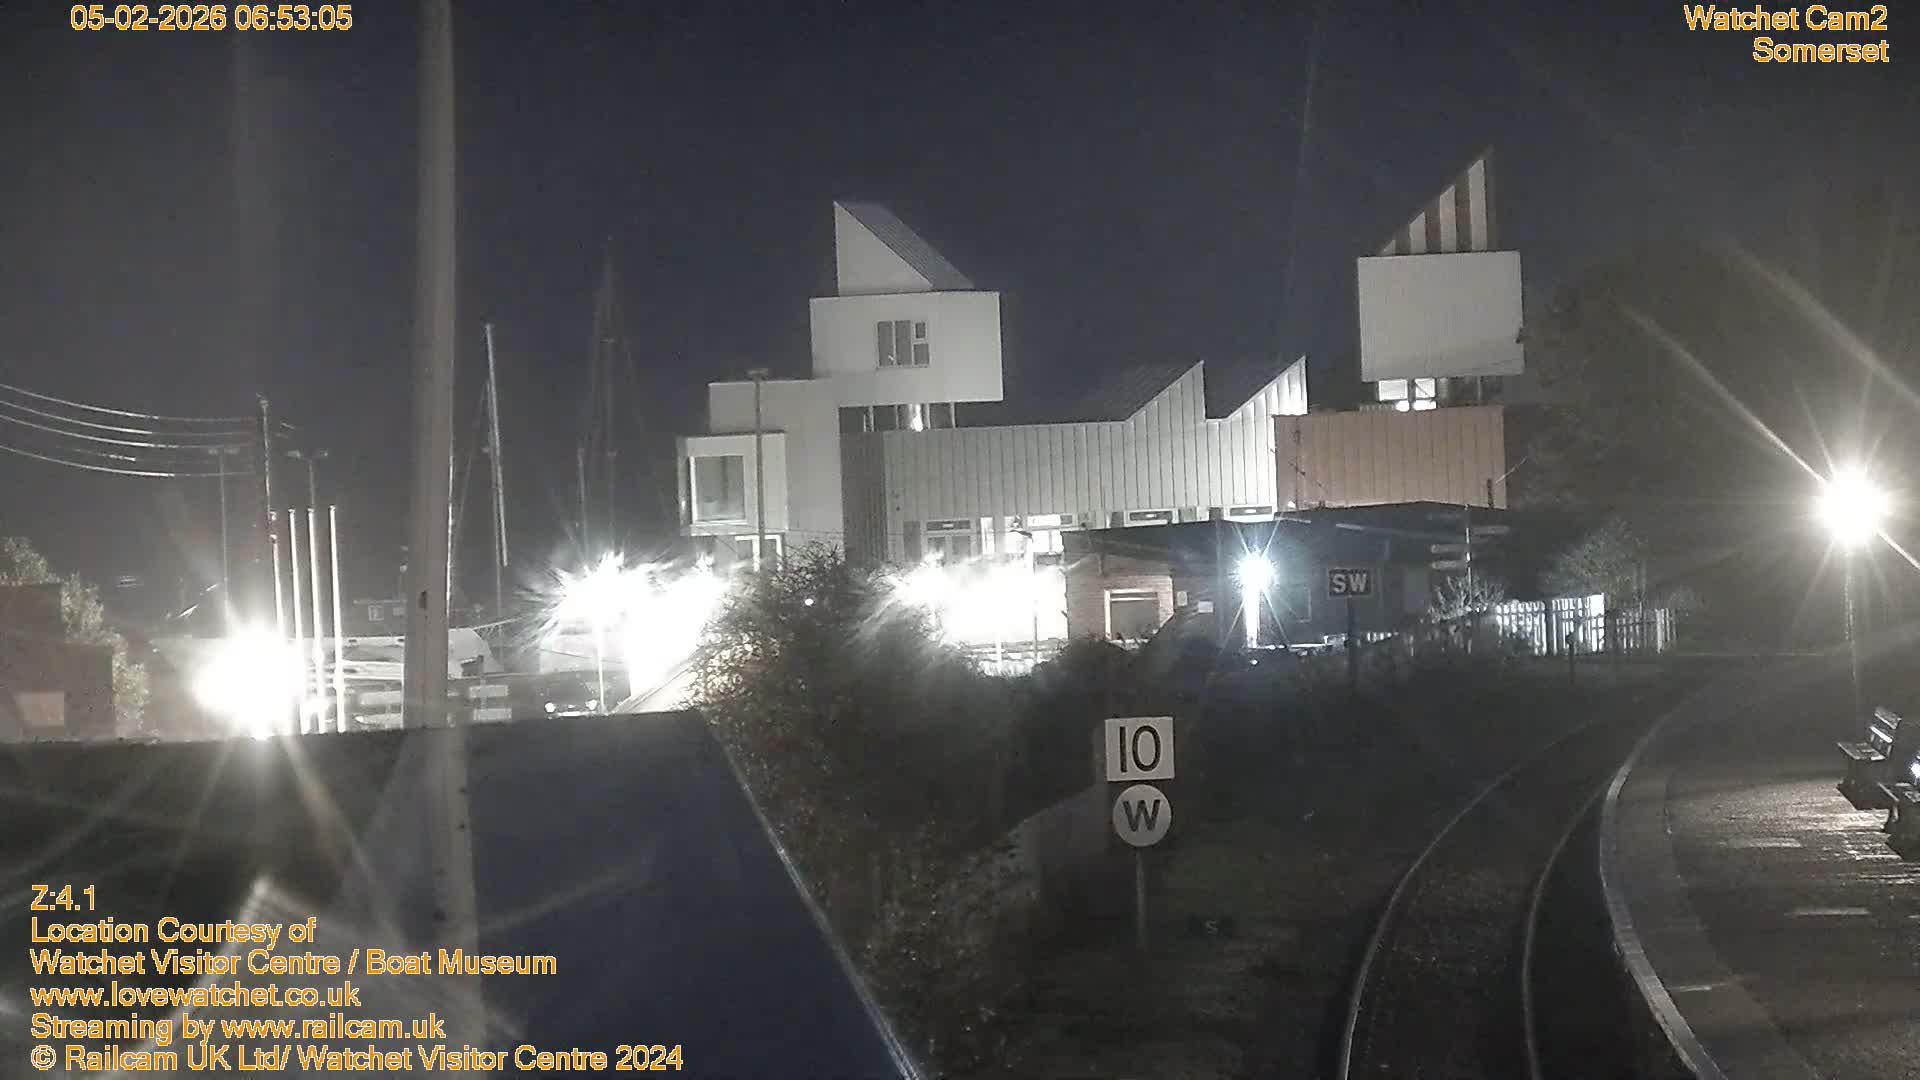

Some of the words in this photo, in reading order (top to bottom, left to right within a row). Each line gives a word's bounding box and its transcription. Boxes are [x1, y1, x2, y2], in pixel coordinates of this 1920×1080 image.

[1332, 573, 1367, 592] SW
[1119, 724, 1161, 773] 10
[1122, 799, 1161, 832] W
